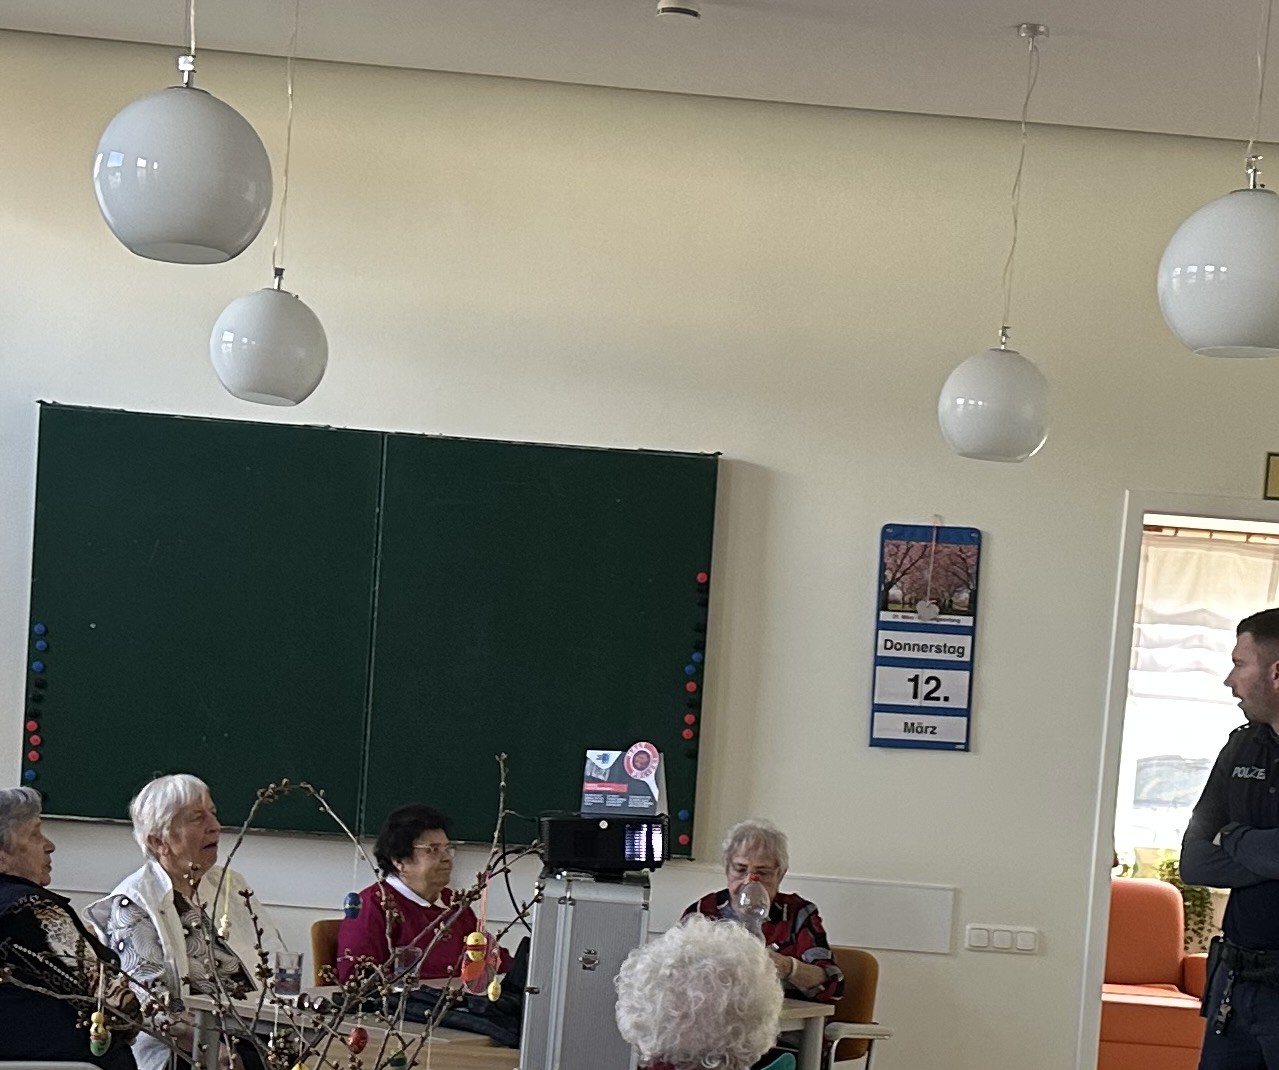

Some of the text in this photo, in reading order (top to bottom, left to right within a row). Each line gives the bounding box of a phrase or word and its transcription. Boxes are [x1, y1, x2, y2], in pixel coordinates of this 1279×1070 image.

[884, 639, 965, 658] Donnerstag
[907, 674, 950, 702] 12.
[903, 721, 937, 735] März
